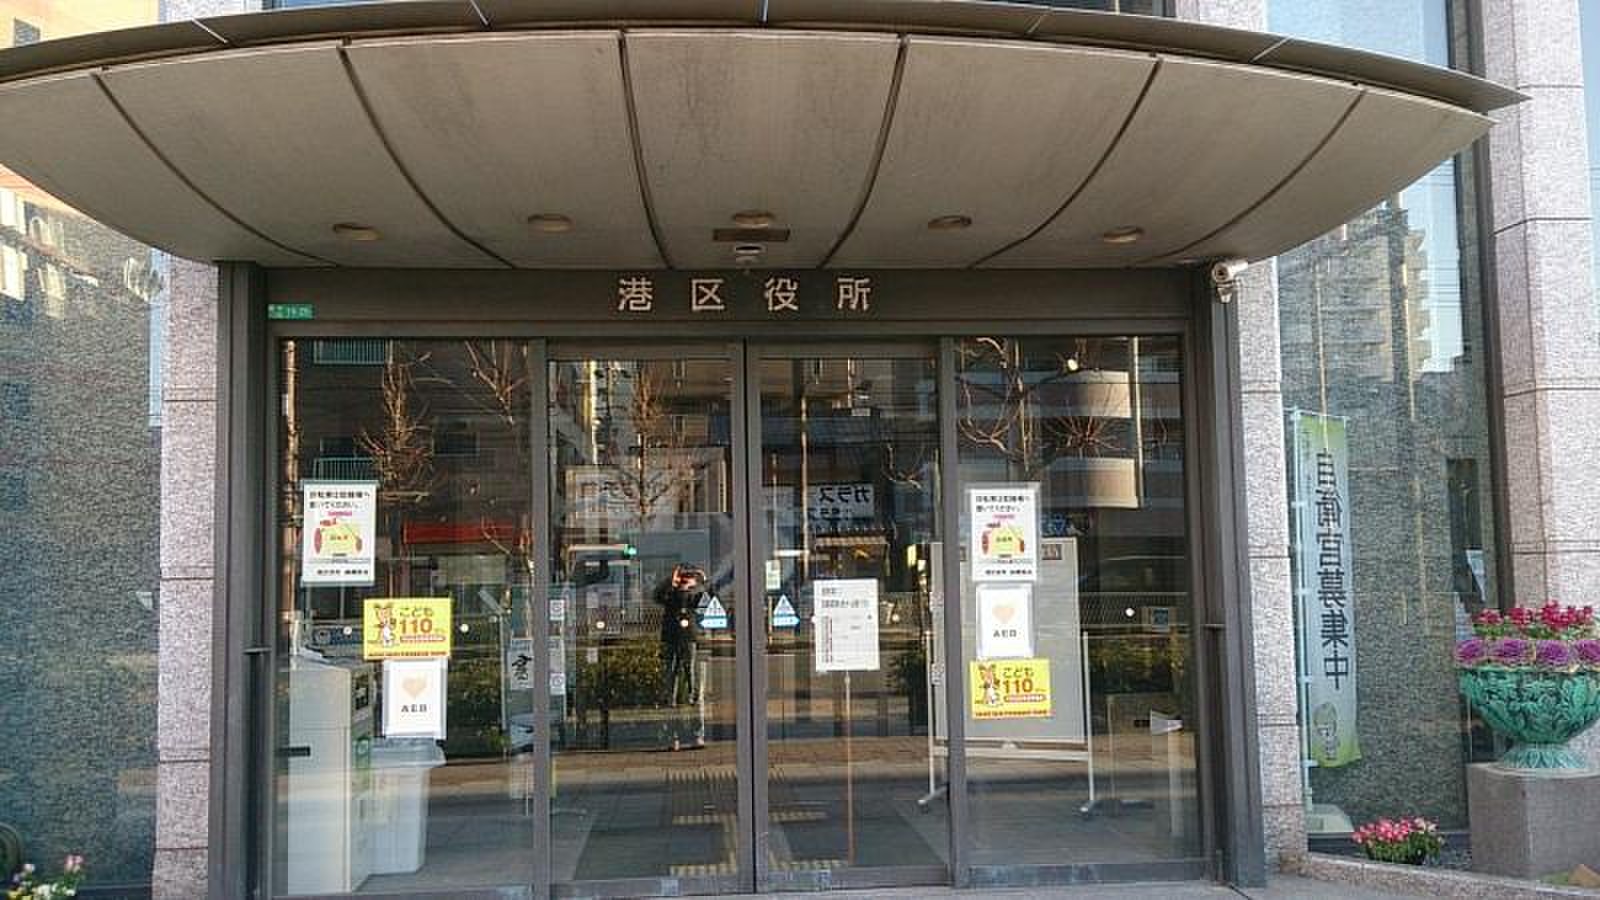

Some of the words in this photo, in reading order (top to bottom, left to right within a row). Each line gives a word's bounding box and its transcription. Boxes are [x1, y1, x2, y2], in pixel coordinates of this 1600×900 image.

[618, 278, 871, 311] 港区役所
[400, 607, 433, 617] こども
[400, 619, 433, 634] 110
[993, 629, 1017, 637] AED
[1003, 667, 1034, 678] こども
[1002, 679, 1033, 693] 110
